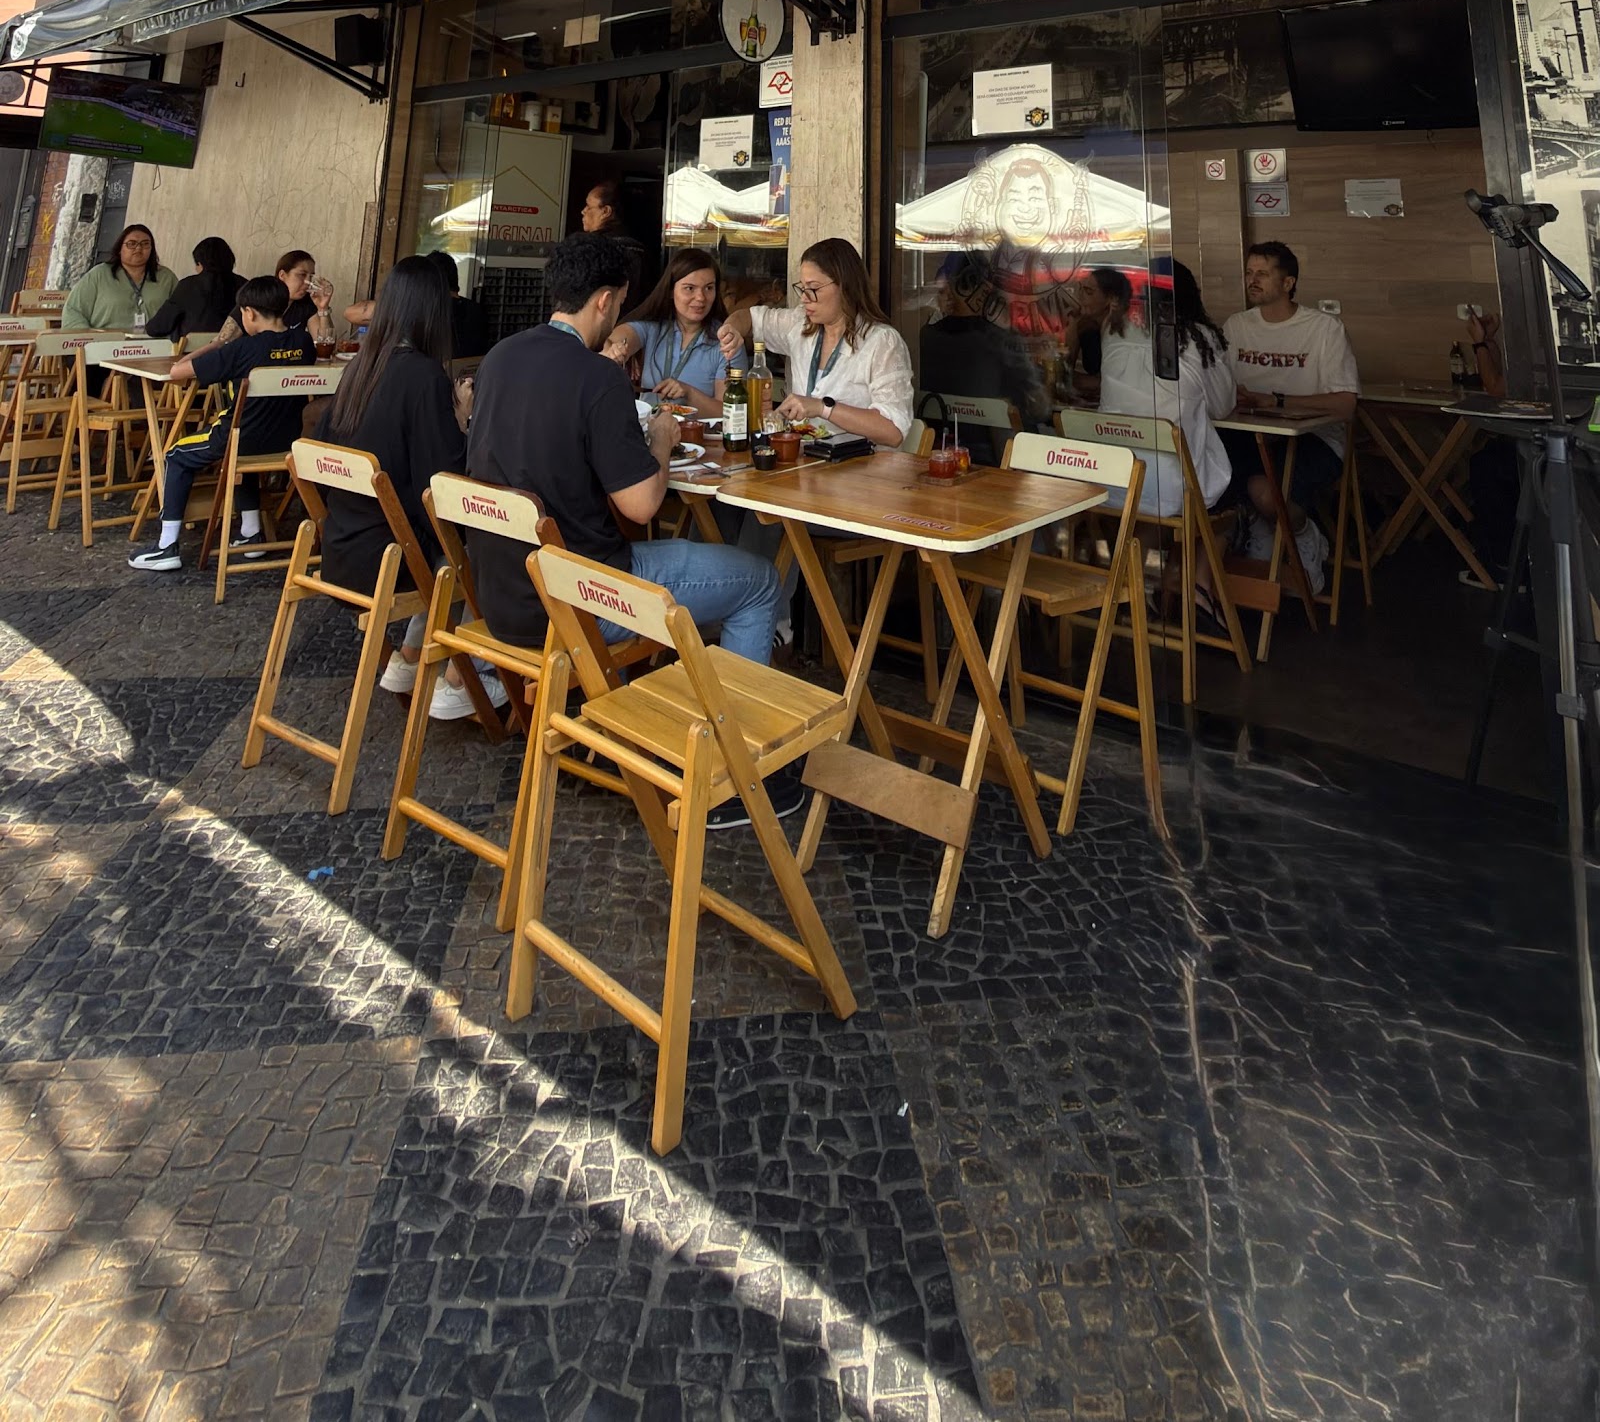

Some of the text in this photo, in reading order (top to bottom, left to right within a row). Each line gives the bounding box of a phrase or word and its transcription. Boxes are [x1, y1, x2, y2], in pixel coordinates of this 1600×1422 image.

[774, 117, 785, 126] RED
[782, 127, 789, 136] TE
[775, 137, 791, 147] AAAS
[494, 205, 533, 213] NTARCTICA
[491, 224, 552, 242] IGINAL
[1009, 285, 1083, 337] RIVA
[62, 340, 88, 350] ORIGI
[113, 348, 151, 358] ORIGINAL
[1237, 348, 1309, 368] MICKEY
[281, 377, 328, 389] ORIGINAL
[945, 404, 986, 417] ORIGINAL
[1095, 423, 1145, 439] ORIGINAL
[1047, 450, 1099, 470] ORIGINAL
[316, 458, 353, 478] ORIGINAL
[462, 496, 510, 522] ORIGINAL
[577, 580, 637, 619] ORIGINAL
